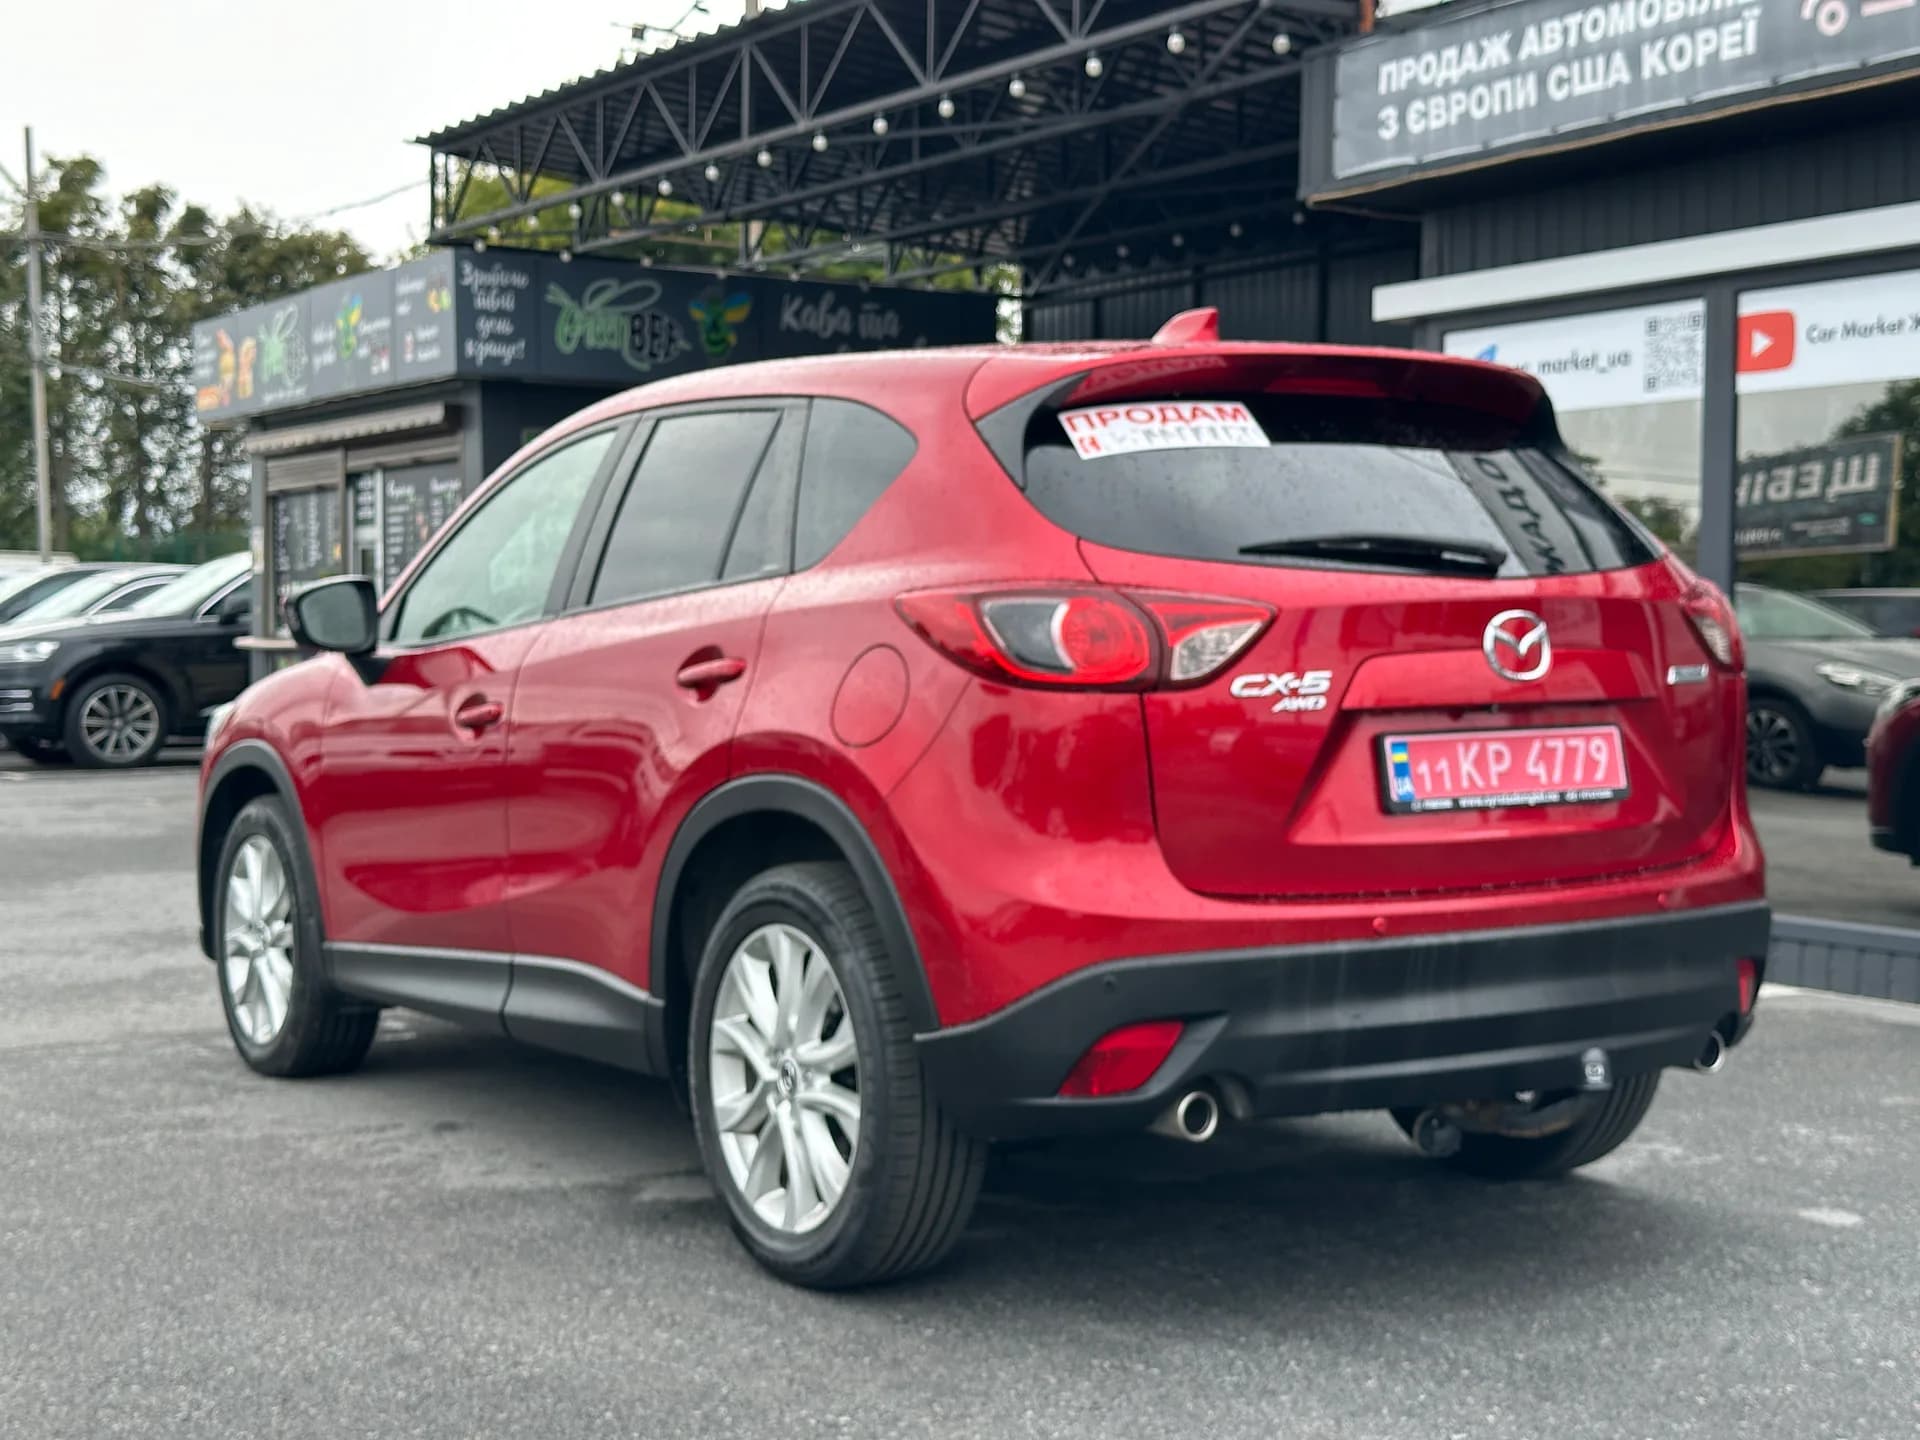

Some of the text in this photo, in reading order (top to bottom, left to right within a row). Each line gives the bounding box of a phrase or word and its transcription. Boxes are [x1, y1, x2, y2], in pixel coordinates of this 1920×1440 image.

[1377, 30, 1512, 95] ПРОДАЖ
[1377, 8, 1762, 140] З ЄВРОПИ США КОРЕЇ
[780, 291, 850, 338] Кава
[1806, 323, 1838, 344] Car
[1841, 313, 1906, 341] Market
[1066, 404, 1250, 433] ПРОДАМ
[1230, 669, 1333, 698] CX-5
[1271, 694, 1328, 713] AWD
[1526, 734, 1609, 786] 4779
